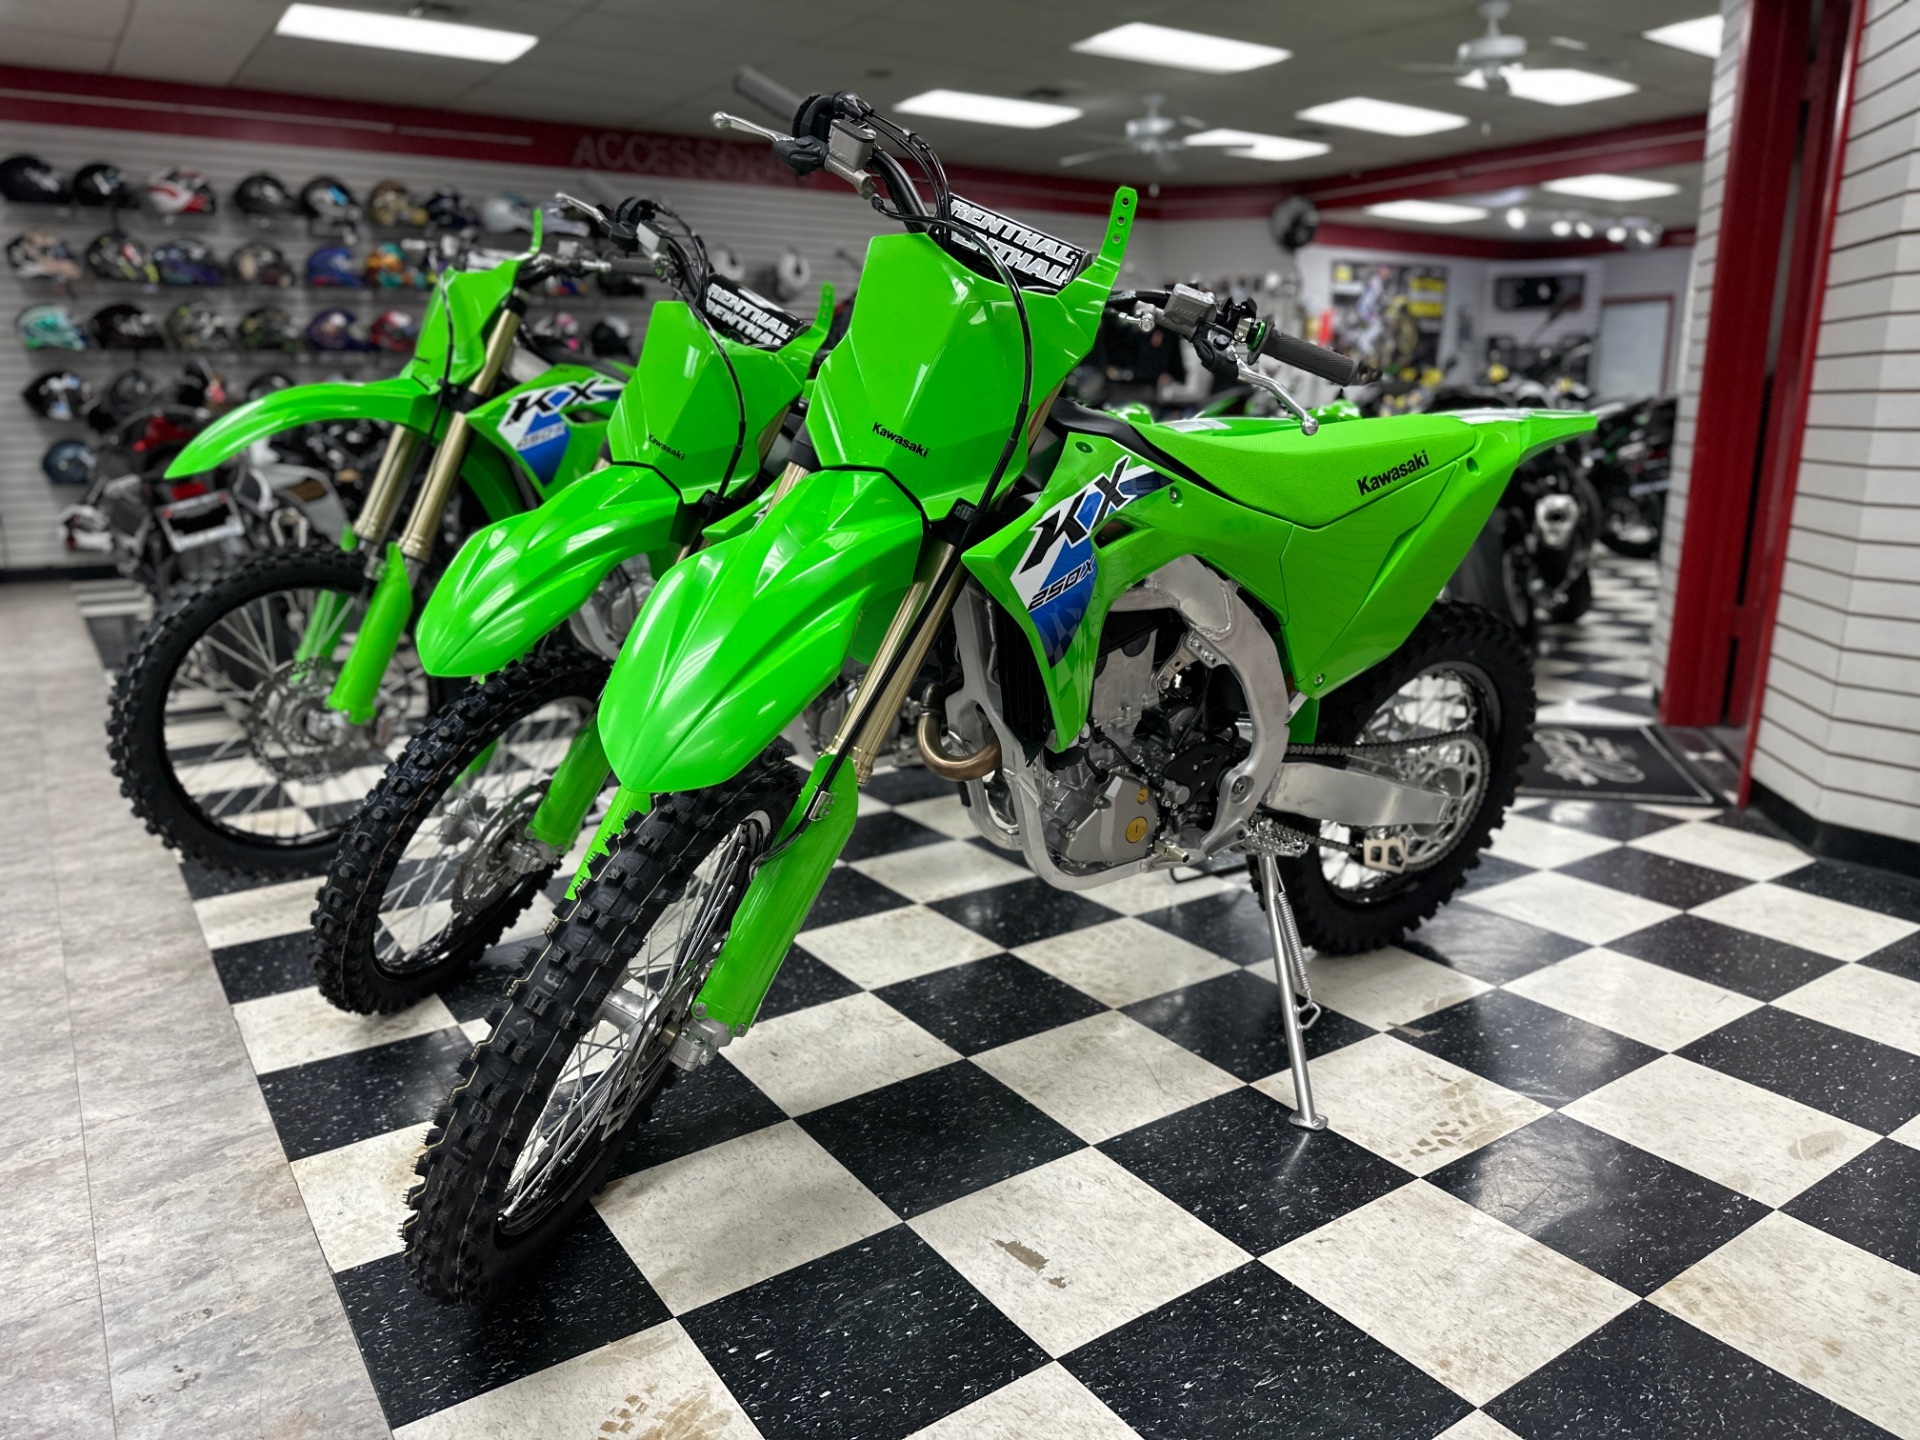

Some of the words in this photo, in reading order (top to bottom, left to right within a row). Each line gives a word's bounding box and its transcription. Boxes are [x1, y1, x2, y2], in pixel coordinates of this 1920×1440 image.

[944, 228, 1069, 287] ENTHAL
[950, 198, 1073, 266] RENTHAL
[707, 282, 789, 341] RENTHAL
[503, 379, 601, 427] KX
[648, 432, 686, 460] Kawasaki
[872, 421, 930, 458] Kawasaki
[1356, 449, 1430, 496] Kawasaki
[1018, 455, 1131, 575] KX
